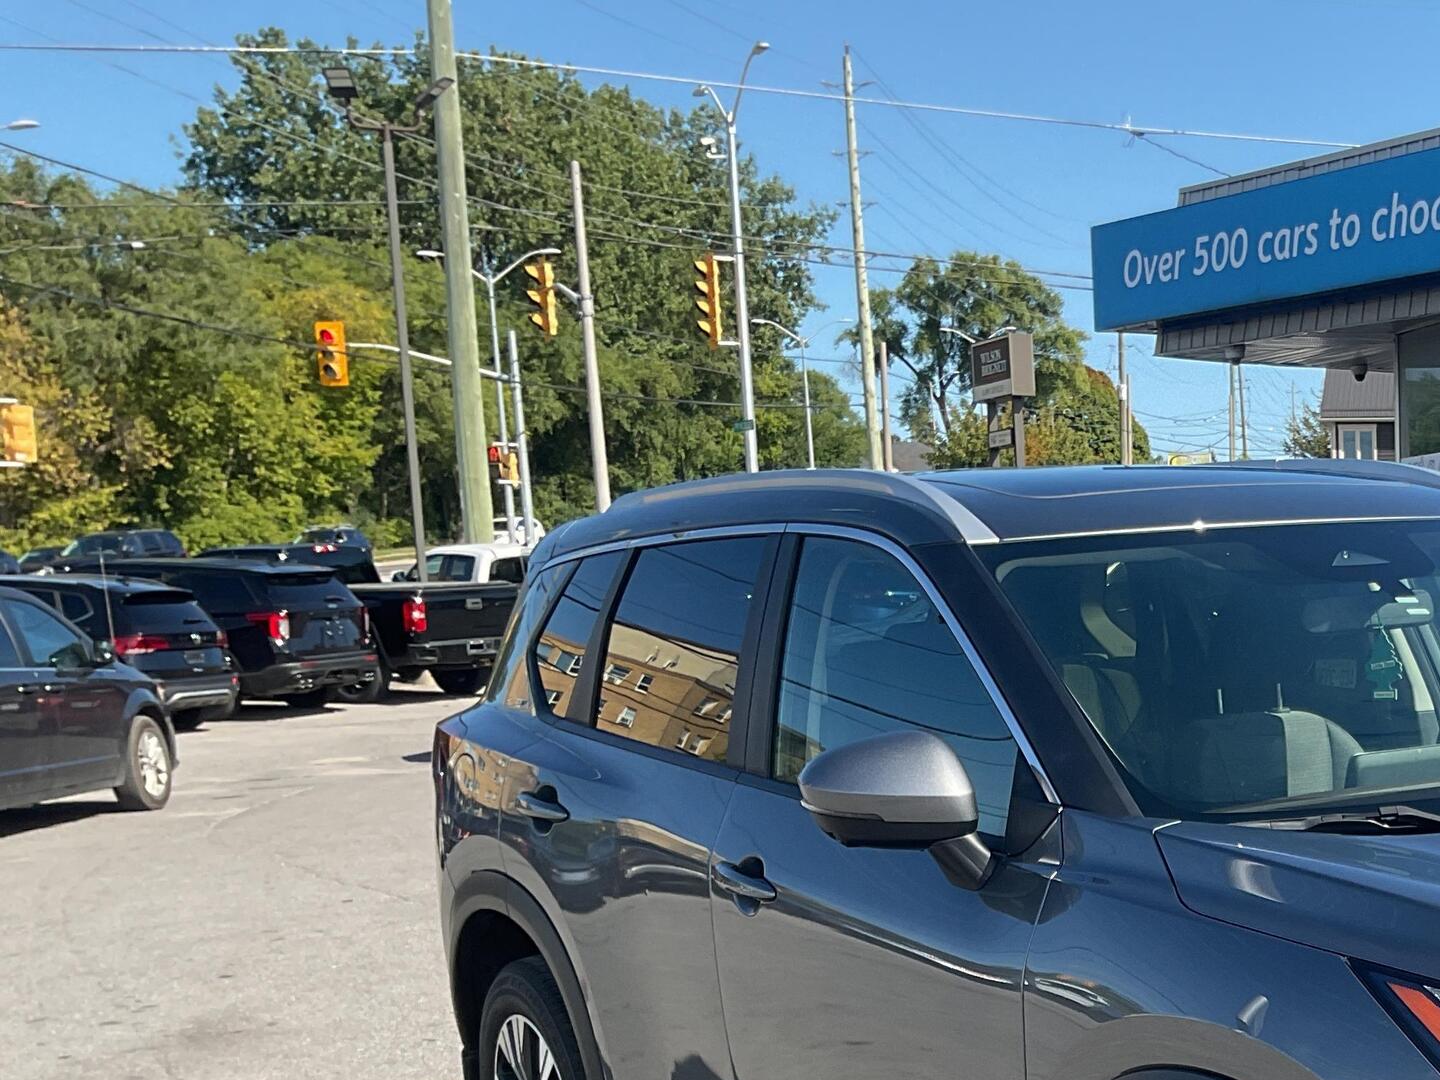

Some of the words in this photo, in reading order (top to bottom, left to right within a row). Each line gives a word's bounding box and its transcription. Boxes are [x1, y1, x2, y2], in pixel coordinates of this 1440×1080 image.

[1123, 249, 1186, 288] Over
[1192, 227, 1248, 276] 500
[1257, 222, 1319, 264] cars
[1329, 208, 1360, 250] to
